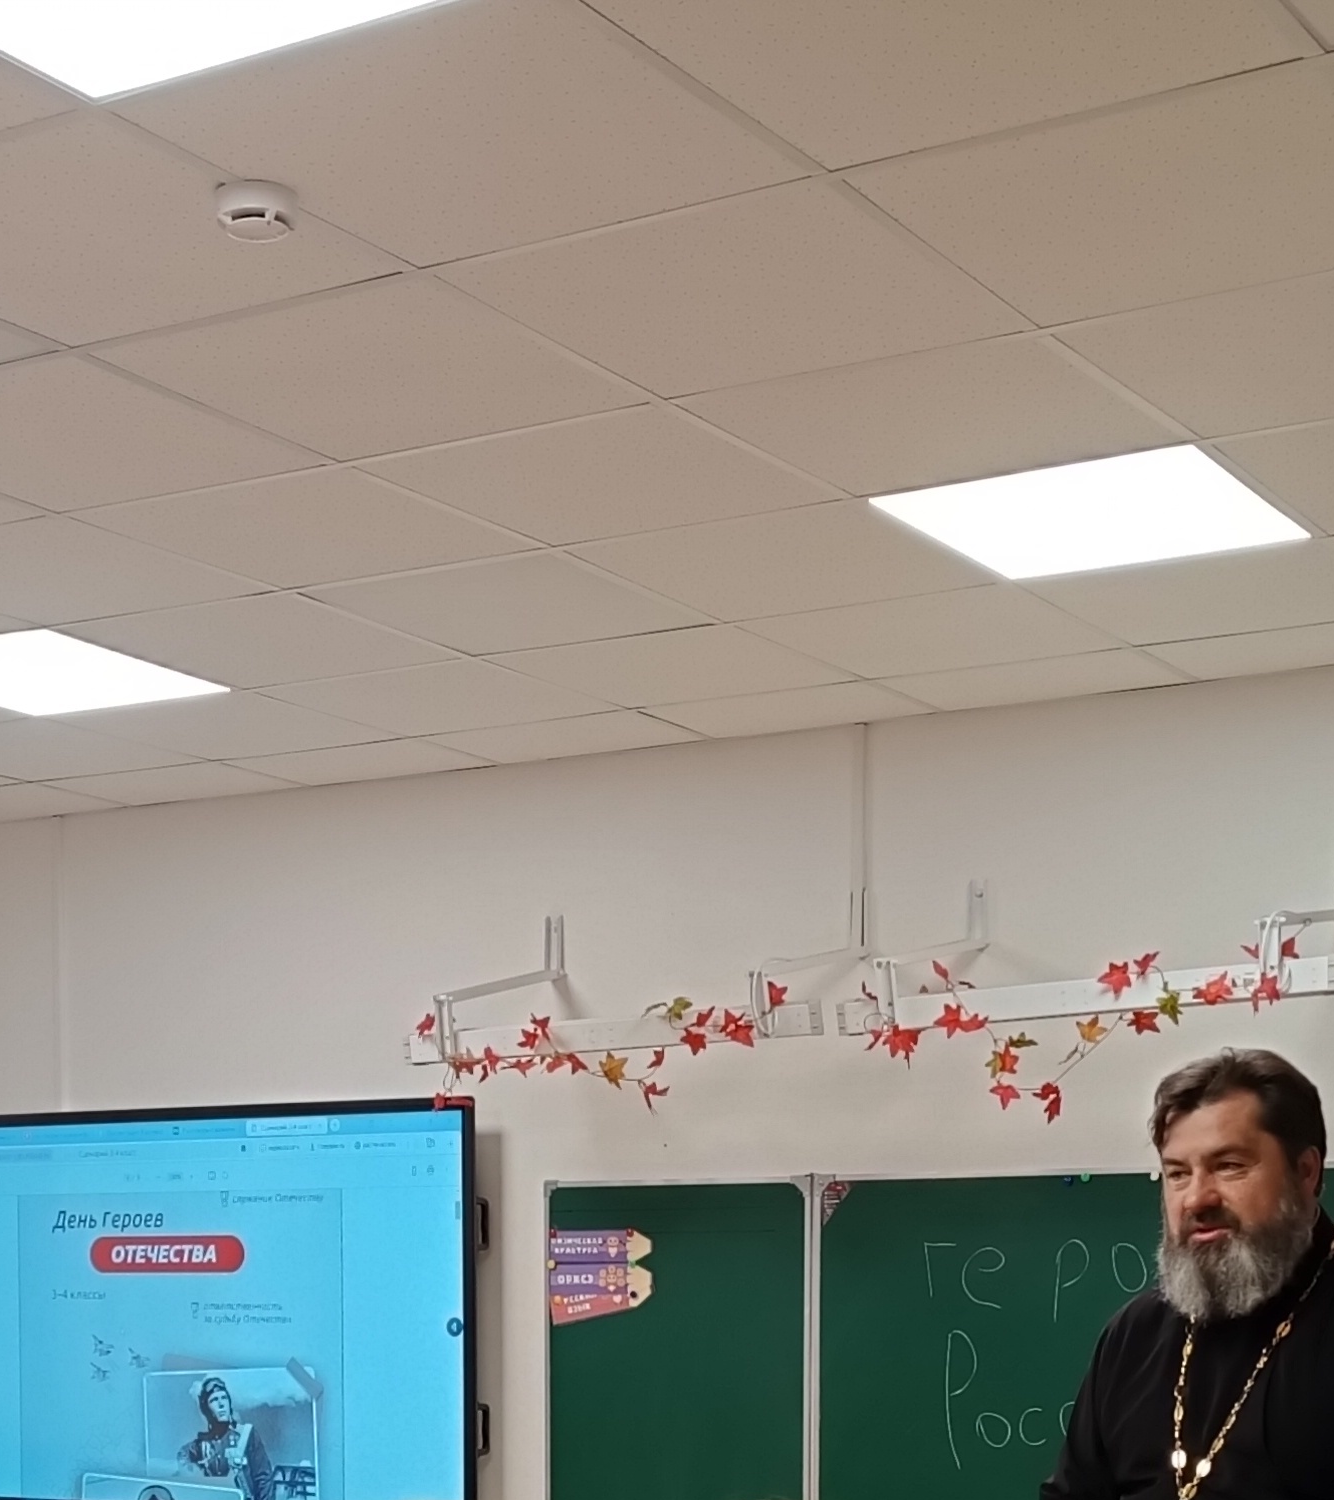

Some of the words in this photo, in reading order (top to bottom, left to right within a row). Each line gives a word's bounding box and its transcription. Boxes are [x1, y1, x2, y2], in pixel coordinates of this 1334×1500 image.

[52, 1210, 97, 1234] День
[102, 1211, 164, 1232] Героев
[111, 1244, 217, 1263] ОТЕЧЕСТВА
[69, 1290, 106, 1300] классы
[945, 1330, 1076, 1469] Росс
